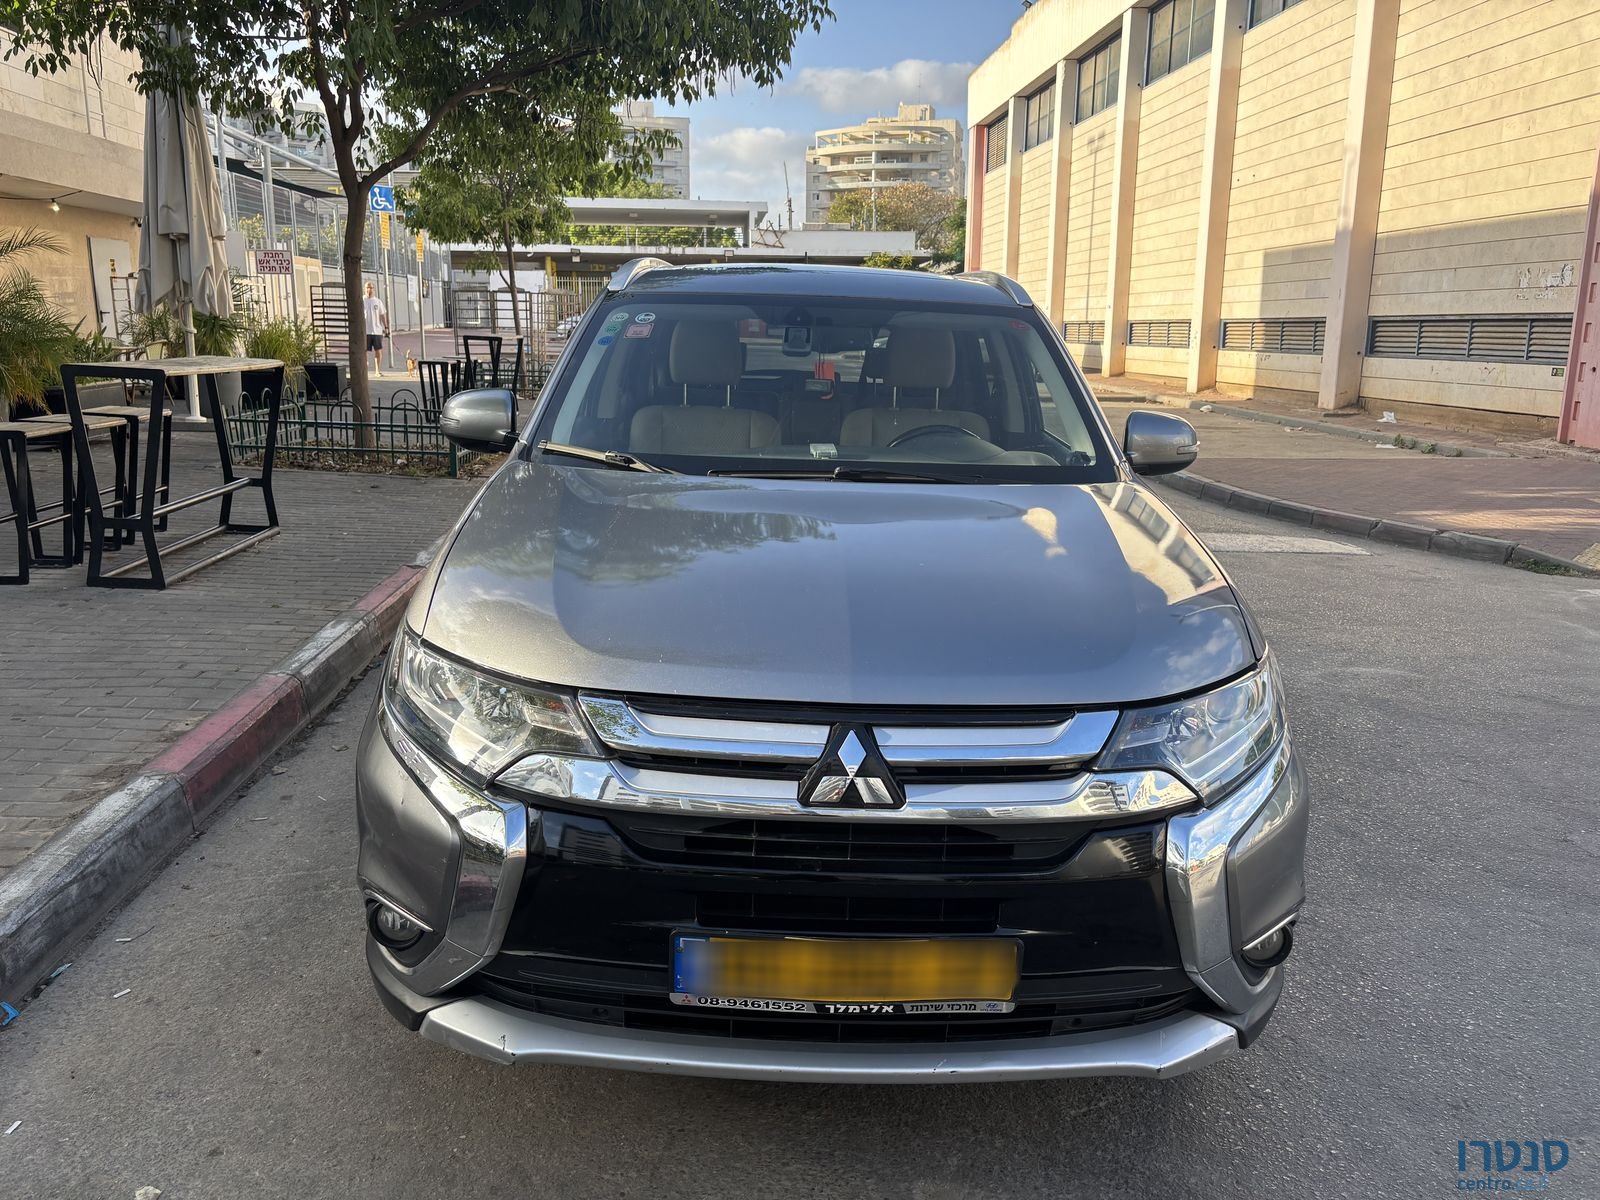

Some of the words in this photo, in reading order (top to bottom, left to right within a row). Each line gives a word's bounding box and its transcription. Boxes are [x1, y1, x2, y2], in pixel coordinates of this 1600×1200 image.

[697, 996, 806, 1012] 08-9461552
[825, 1003, 894, 1014] אלימלך
[910, 1002, 944, 1012] שירות
[947, 1002, 977, 1012] מרכזי
